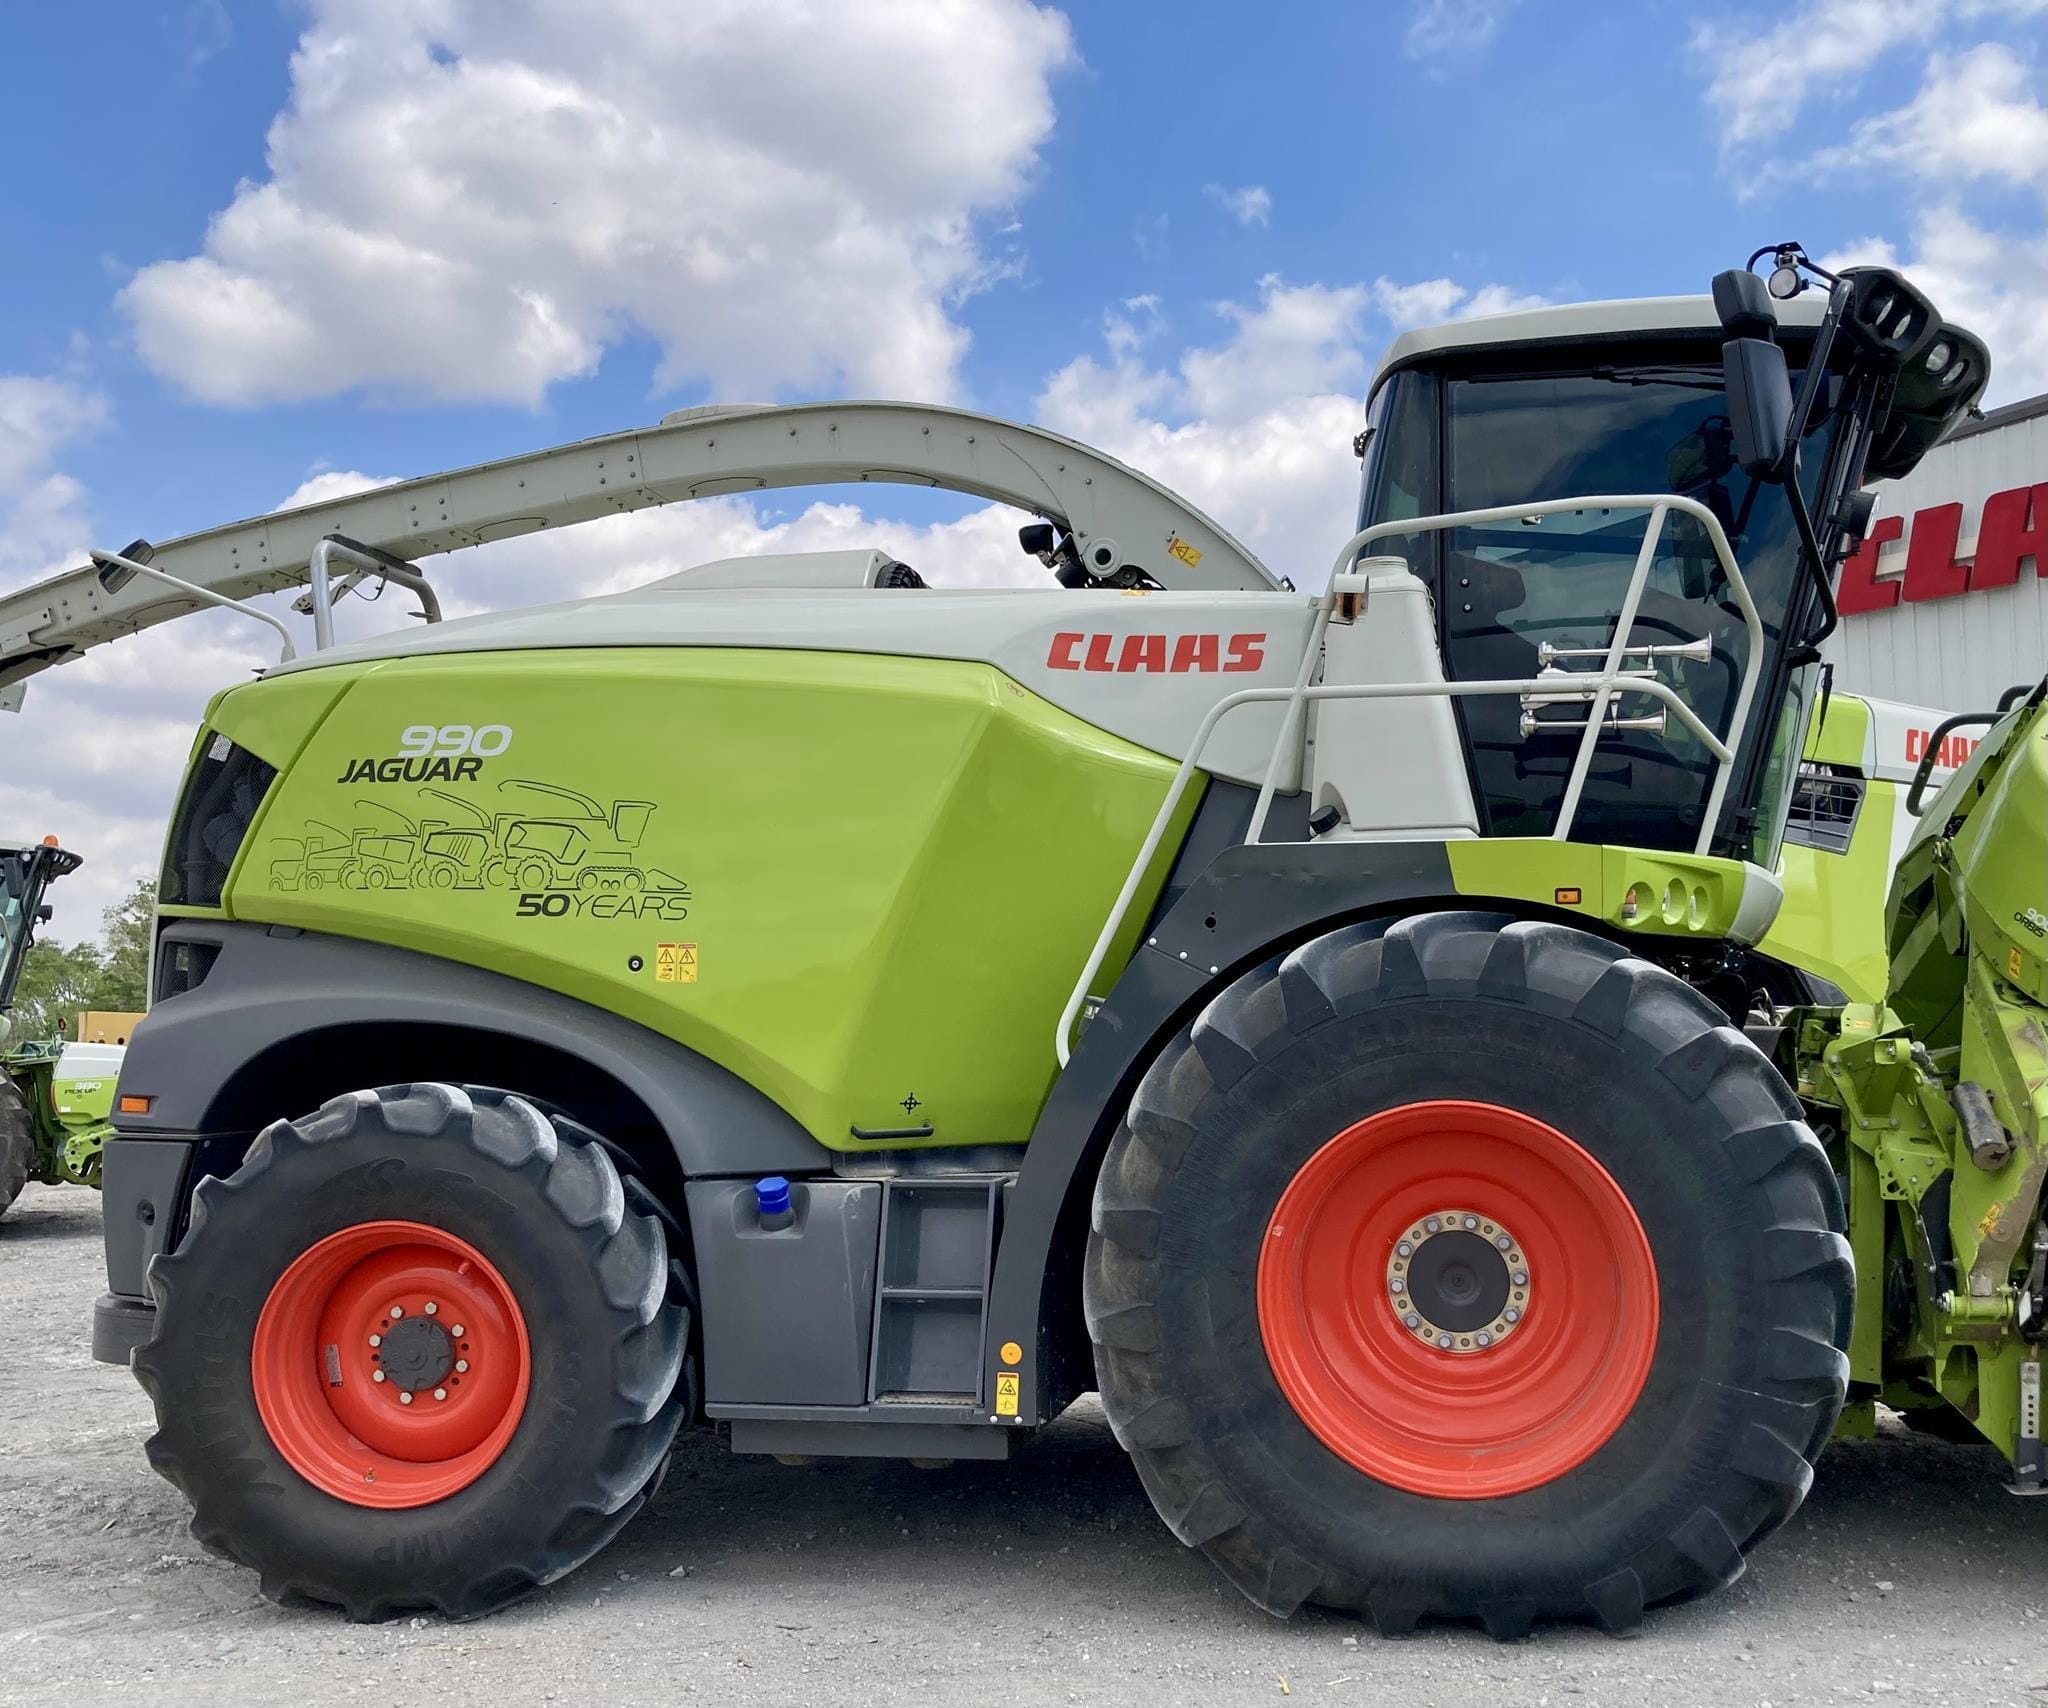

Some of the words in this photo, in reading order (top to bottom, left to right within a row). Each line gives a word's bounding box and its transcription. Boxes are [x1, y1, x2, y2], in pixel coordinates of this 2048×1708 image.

[1047, 632, 1268, 673] CLAAS
[398, 724, 513, 758] 990
[1905, 728, 1981, 769] CLAA
[337, 757, 484, 784] JAGUAR
[2013, 911, 2046, 938] ORBIS
